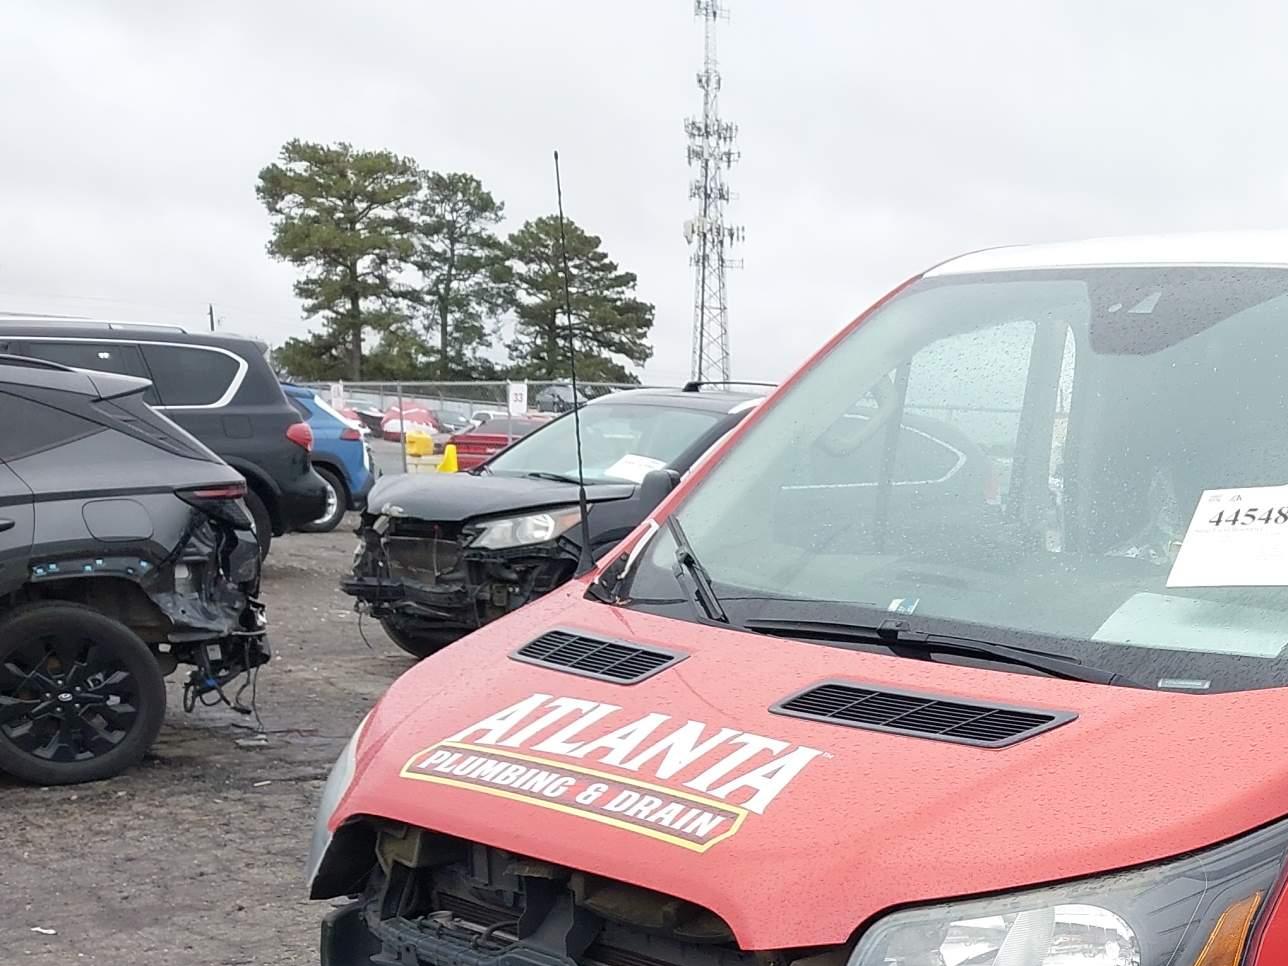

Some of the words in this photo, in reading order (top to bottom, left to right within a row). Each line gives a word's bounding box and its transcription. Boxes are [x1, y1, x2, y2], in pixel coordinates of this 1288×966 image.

[416, 750, 576, 799] PLUMBING
[575, 783, 609, 804] &
[604, 788, 724, 838] DRAIN
[446, 693, 822, 815] ATLANTA
